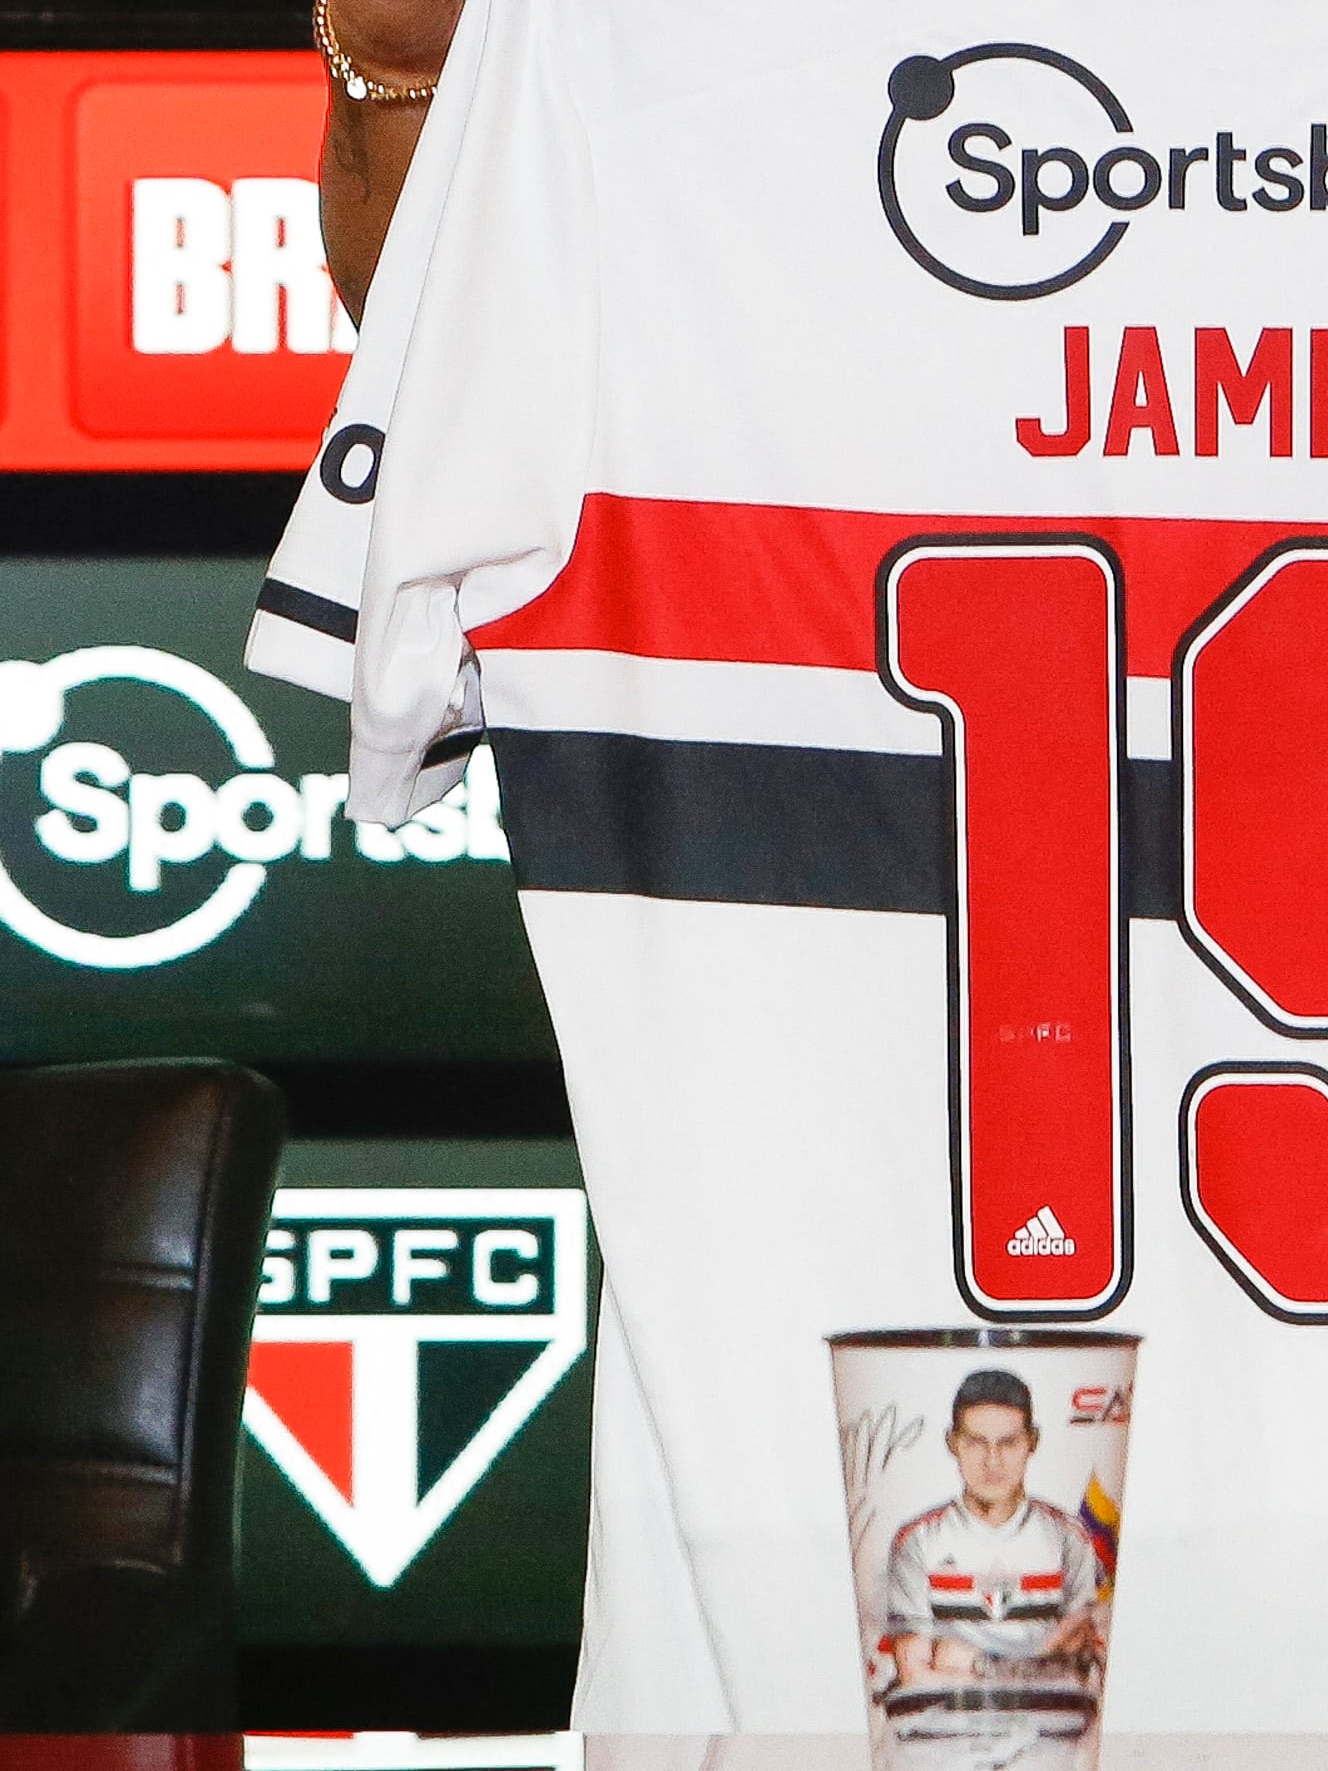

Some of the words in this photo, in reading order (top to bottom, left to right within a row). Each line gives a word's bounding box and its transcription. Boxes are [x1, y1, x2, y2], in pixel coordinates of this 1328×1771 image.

[132, 177, 358, 354] BR
[259, 1229, 539, 1305] SPFC
[1007, 1236, 1076, 1256] adidas
